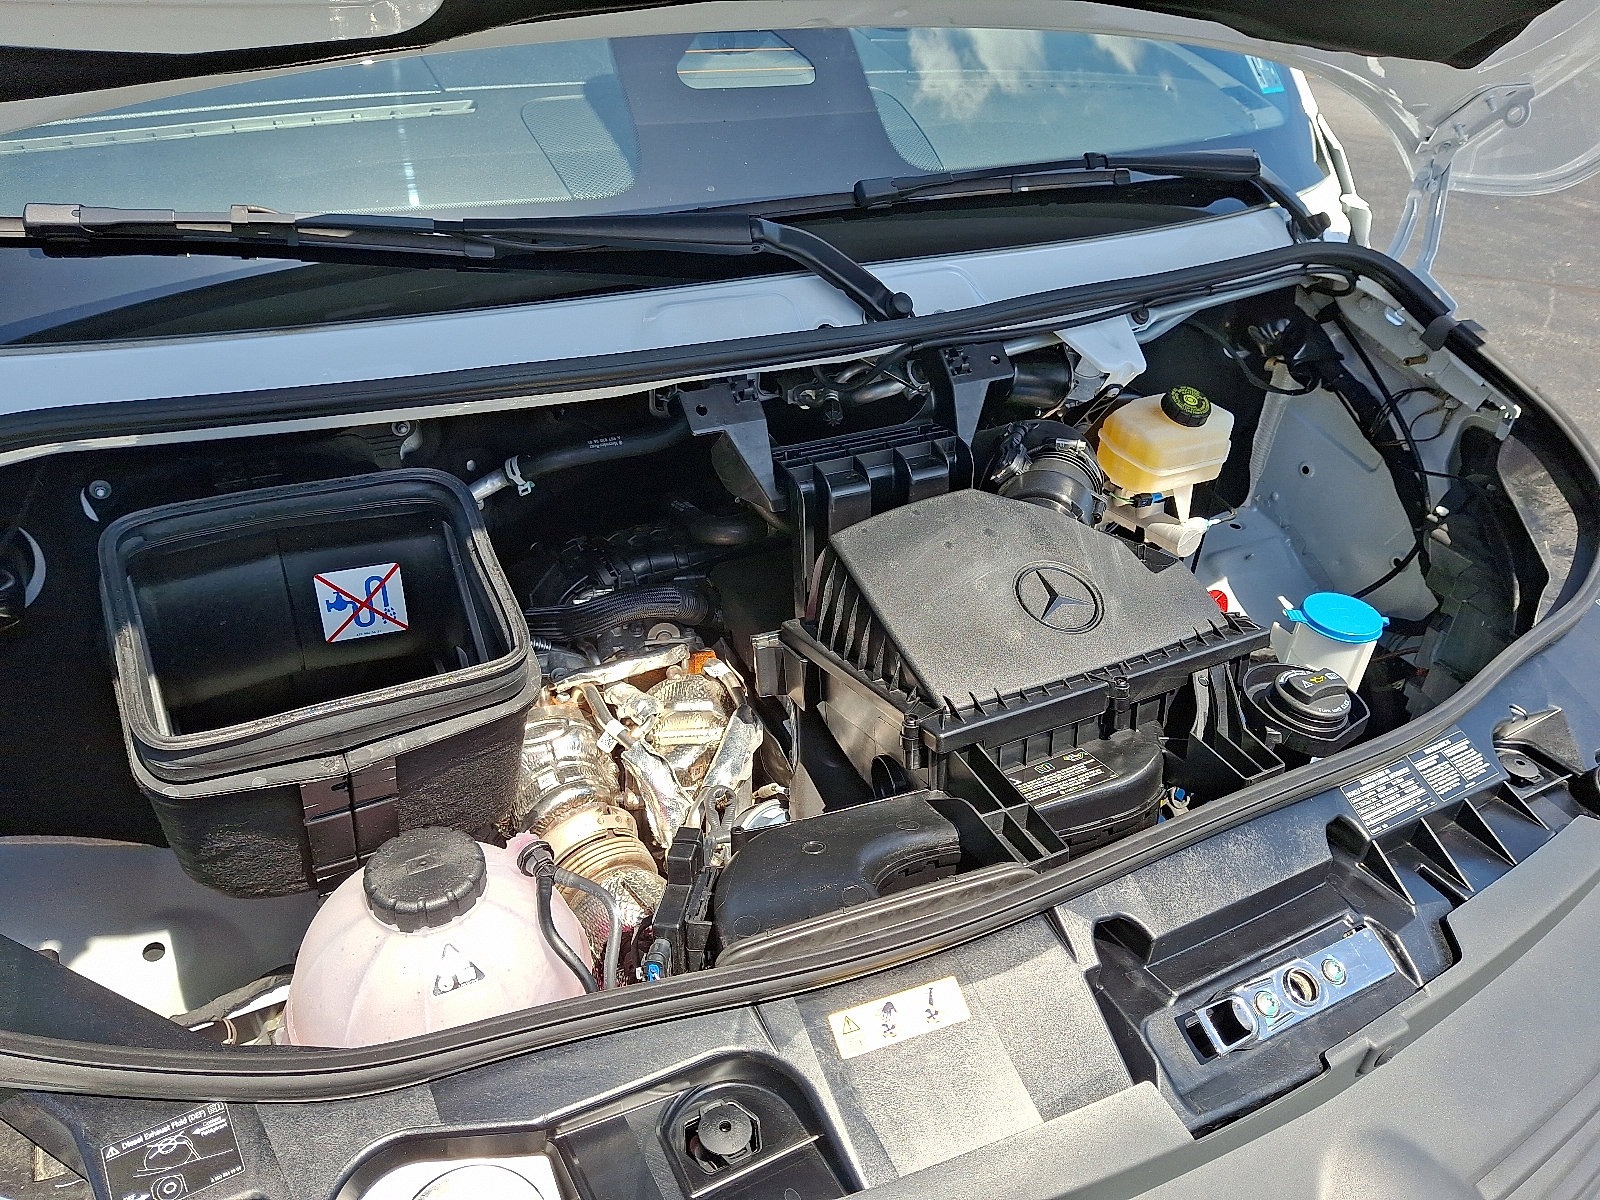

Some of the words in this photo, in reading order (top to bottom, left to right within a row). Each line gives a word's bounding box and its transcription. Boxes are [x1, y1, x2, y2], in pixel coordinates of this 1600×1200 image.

[121, 1137, 143, 1150] Diesel
[144, 1125, 171, 1139] Exhaust
[171, 1116, 187, 1130] Fluid
[188, 1110, 206, 1123] (DEF)
